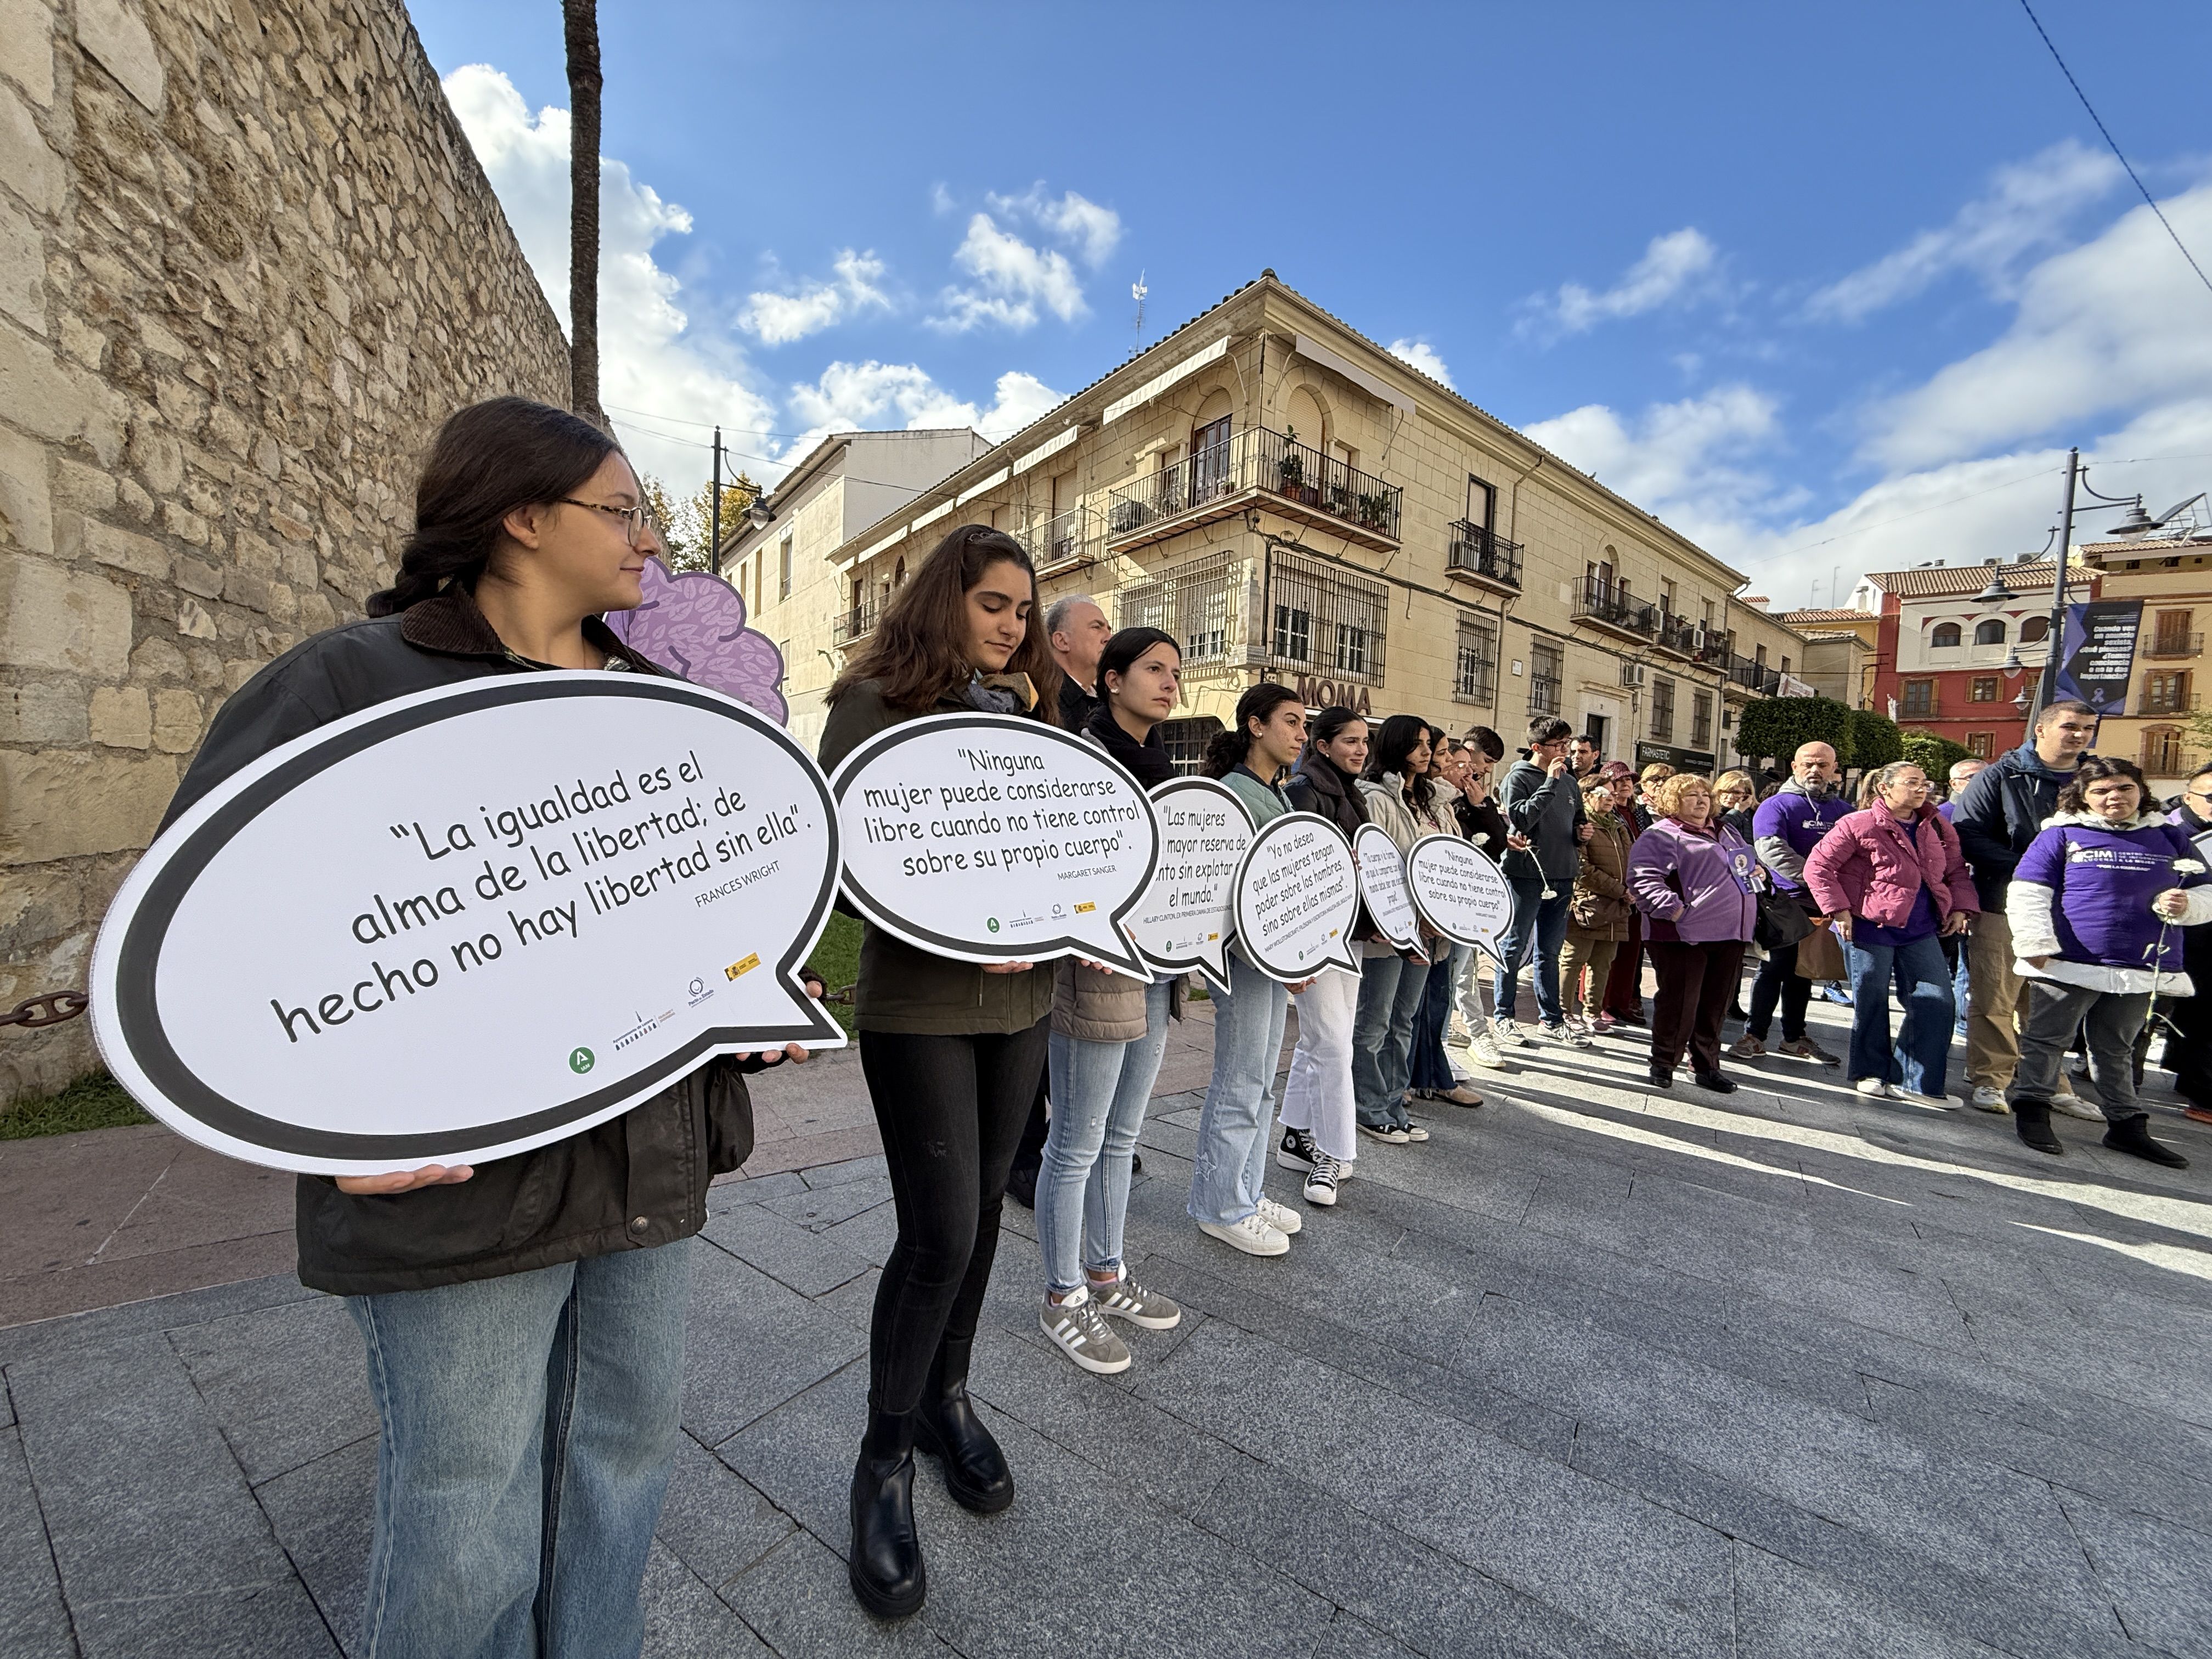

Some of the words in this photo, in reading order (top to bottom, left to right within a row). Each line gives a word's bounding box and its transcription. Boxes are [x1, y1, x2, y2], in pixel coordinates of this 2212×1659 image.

[1296, 675, 1372, 715] MOMA
[958, 748, 1045, 776] "Ninguna
[390, 822, 476, 860] "La
[479, 769, 631, 848] igualdad
[639, 766, 672, 794] es
[679, 750, 703, 782] el
[863, 782, 933, 813] mujer
[940, 779, 1002, 811] puede
[1007, 777, 1116, 801] considerarse
[864, 817, 924, 843] libre
[931, 811, 1001, 838] cuando
[1006, 815, 1029, 832] no
[1032, 808, 1079, 829] tiene
[1083, 800, 1141, 825] control
[1164, 805, 1185, 826] "Las
[1188, 808, 1225, 832] mujeres
[902, 848, 968, 877] sobre
[974, 849, 997, 869] su
[1003, 838, 1059, 871] propio
[1167, 838, 1197, 859] mayor
[1200, 838, 1234, 852] reserva
[1236, 833, 1246, 850] de
[1266, 844, 1282, 859] "Yo
[1283, 842, 1292, 855] no
[1294, 832, 1314, 849] deseo
[1445, 849, 1473, 866] "Ninguna
[352, 887, 466, 944] alma
[475, 860, 527, 900] de
[530, 845, 571, 881] la
[572, 797, 707, 866] libertad;
[714, 787, 746, 817] de
[1058, 868, 1092, 881] MARGARET
[1092, 865, 1117, 875] SANGER
[1155, 862, 1176, 882] nto
[1179, 861, 1193, 879] sin
[1195, 858, 1233, 883] explotar
[1253, 876, 1268, 896] que
[1267, 868, 1280, 884] las
[1281, 855, 1311, 881] mujeres
[1311, 844, 1334, 862] tengan
[1418, 860, 1437, 873] mujer
[1439, 864, 1458, 875] puede
[1459, 868, 1498, 884] considerarse
[695, 879, 742, 907] FRANCES
[741, 860, 781, 887] WRIGHT
[1169, 887, 1178, 907] el
[1182, 883, 1217, 906] mundo."
[1255, 893, 1278, 920] poder
[1280, 882, 1302, 901] sobre
[1301, 875, 1313, 889] los
[1313, 860, 1345, 883] hombres,
[1418, 871, 1435, 884] libre
[1436, 878, 1458, 889] cuando
[1459, 883, 1467, 891] no
[1468, 882, 1484, 894] tiene
[1485, 888, 1506, 898] control
[1429, 888, 1447, 901] sobre
[1448, 894, 1457, 902] su
[1457, 895, 1477, 908] propio
[1263, 918, 1278, 936] sino
[1280, 905, 1301, 926] sobre
[1302, 894, 1318, 912] ellas
[270, 957, 439, 1043] hecho
[451, 933, 502, 972] no
[507, 900, 577, 946] hay
[584, 840, 710, 915] libertad
[715, 831, 753, 863] sin
